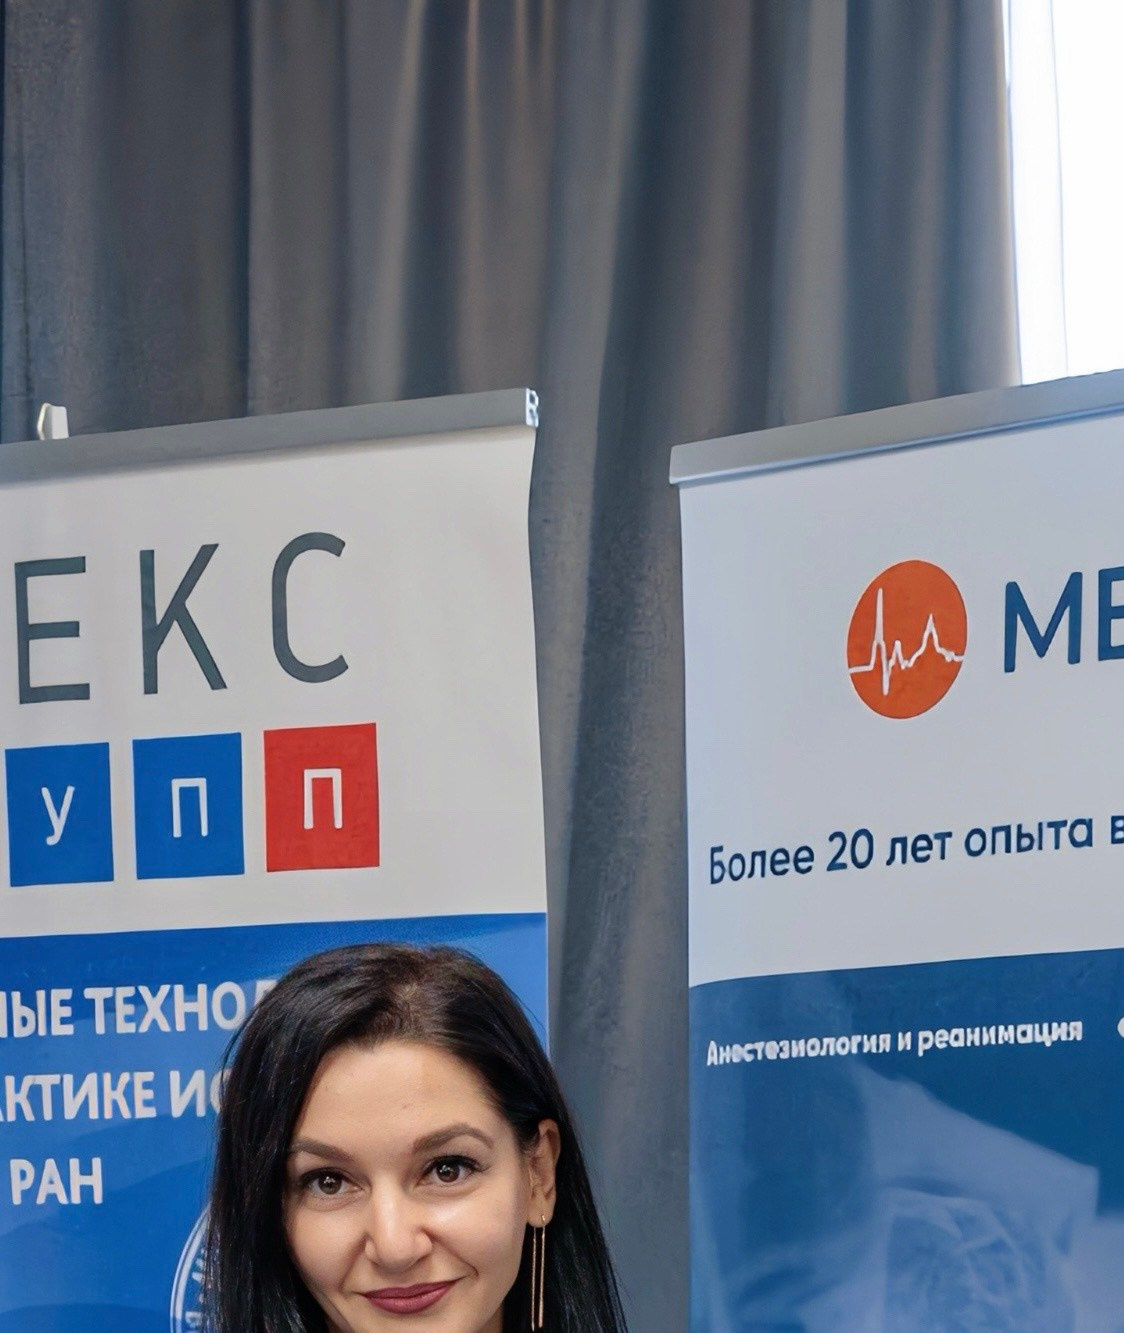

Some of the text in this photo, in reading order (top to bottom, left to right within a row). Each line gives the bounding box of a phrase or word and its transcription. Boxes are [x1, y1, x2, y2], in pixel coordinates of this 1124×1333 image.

[710, 845, 815, 885] Более
[826, 829, 874, 873] 20
[885, 829, 953, 866] лет
[964, 818, 1094, 858] опыта
[0, 988, 74, 1038] ЫЕ
[706, 1032, 892, 1067] Анестезиология
[898, 1031, 912, 1052] и
[918, 1021, 1083, 1057] реанимация
[0, 1072, 156, 1122] КТИКЕ
[10, 1157, 103, 1205] РАН
